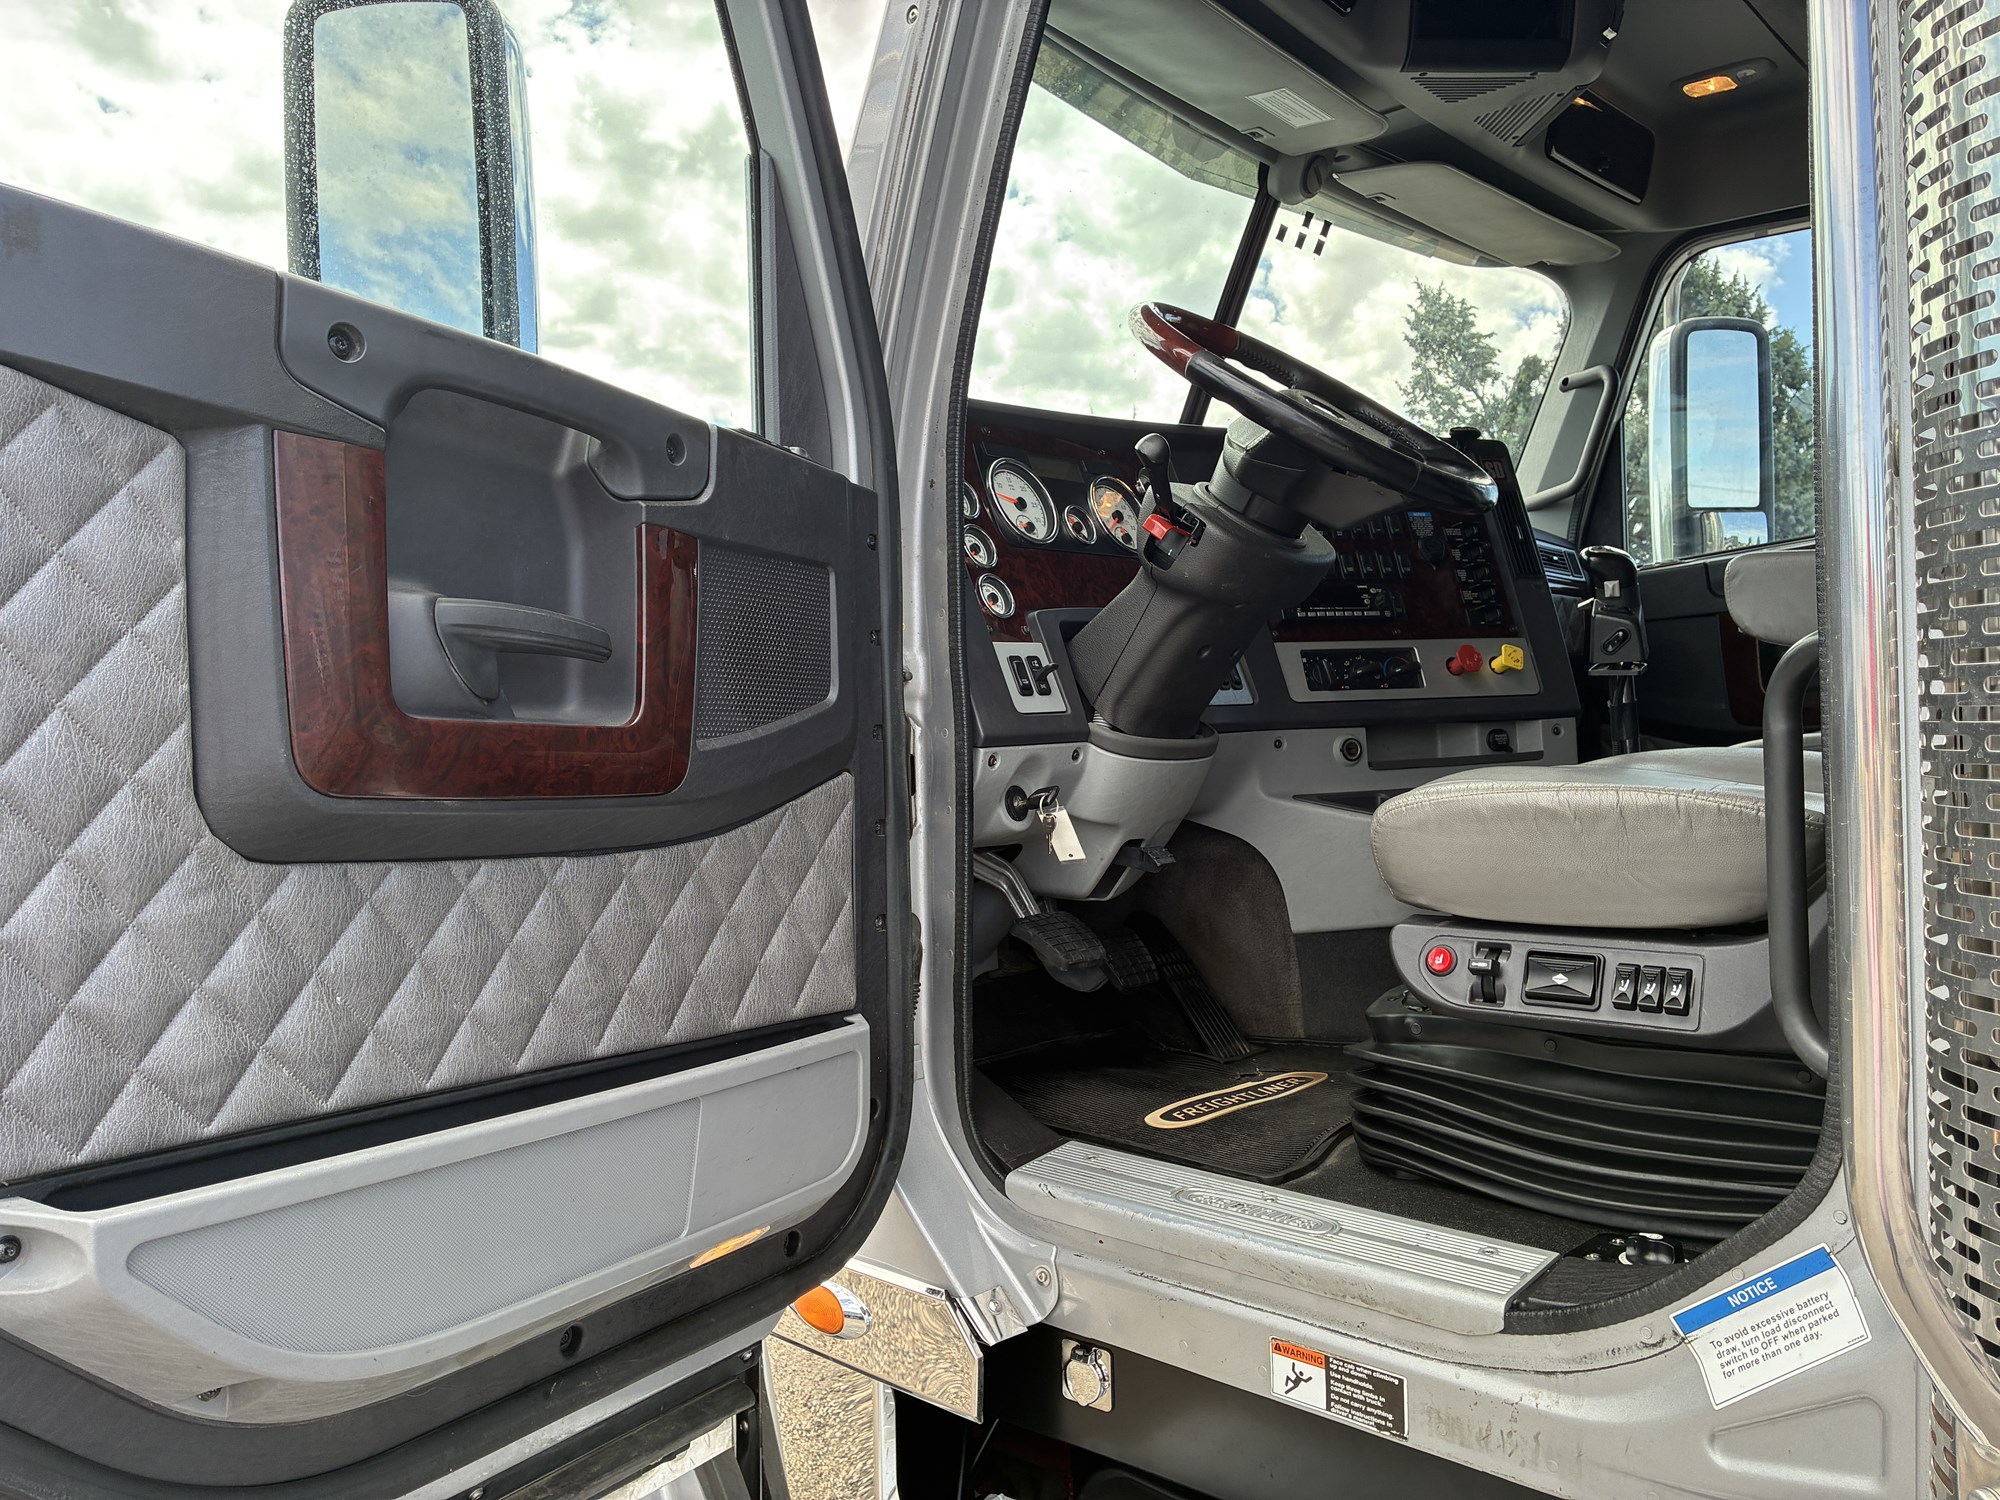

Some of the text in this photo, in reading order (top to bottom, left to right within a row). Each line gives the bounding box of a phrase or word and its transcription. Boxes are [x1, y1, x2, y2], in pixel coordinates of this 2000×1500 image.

[1173, 1077, 1305, 1120] FREIGHTLINER
[1727, 1277, 1778, 1307] NOTICE
[1709, 1291, 1828, 1349] To avoid excessive battery
[1716, 1300, 1834, 1359] draw, turn load disconnect
[1720, 1309, 1840, 1369] switch to OFF when parked
[1282, 1345, 1323, 1366] WARNING
[1722, 1331, 1822, 1379] for more than one day.
[1330, 1358, 1343, 1366] Face
[1356, 1367, 1372, 1375] when
[1373, 1372, 1399, 1385] climbing
[1330, 1371, 1374, 1390] Use handholds.
[1350, 1370, 1368, 1379] down.
[1330, 1380, 1345, 1388] Keep
[1346, 1385, 1361, 1394] three
[1362, 1390, 1378, 1400] limbs
[1330, 1386, 1383, 1407] contact with truck.
[1331, 1393, 1339, 1401] Do
[1351, 1401, 1366, 1410] carry
[1366, 1407, 1394, 1420] anything.
[1331, 1402, 1350, 1412] Follow
[1351, 1409, 1385, 1425] instructions
